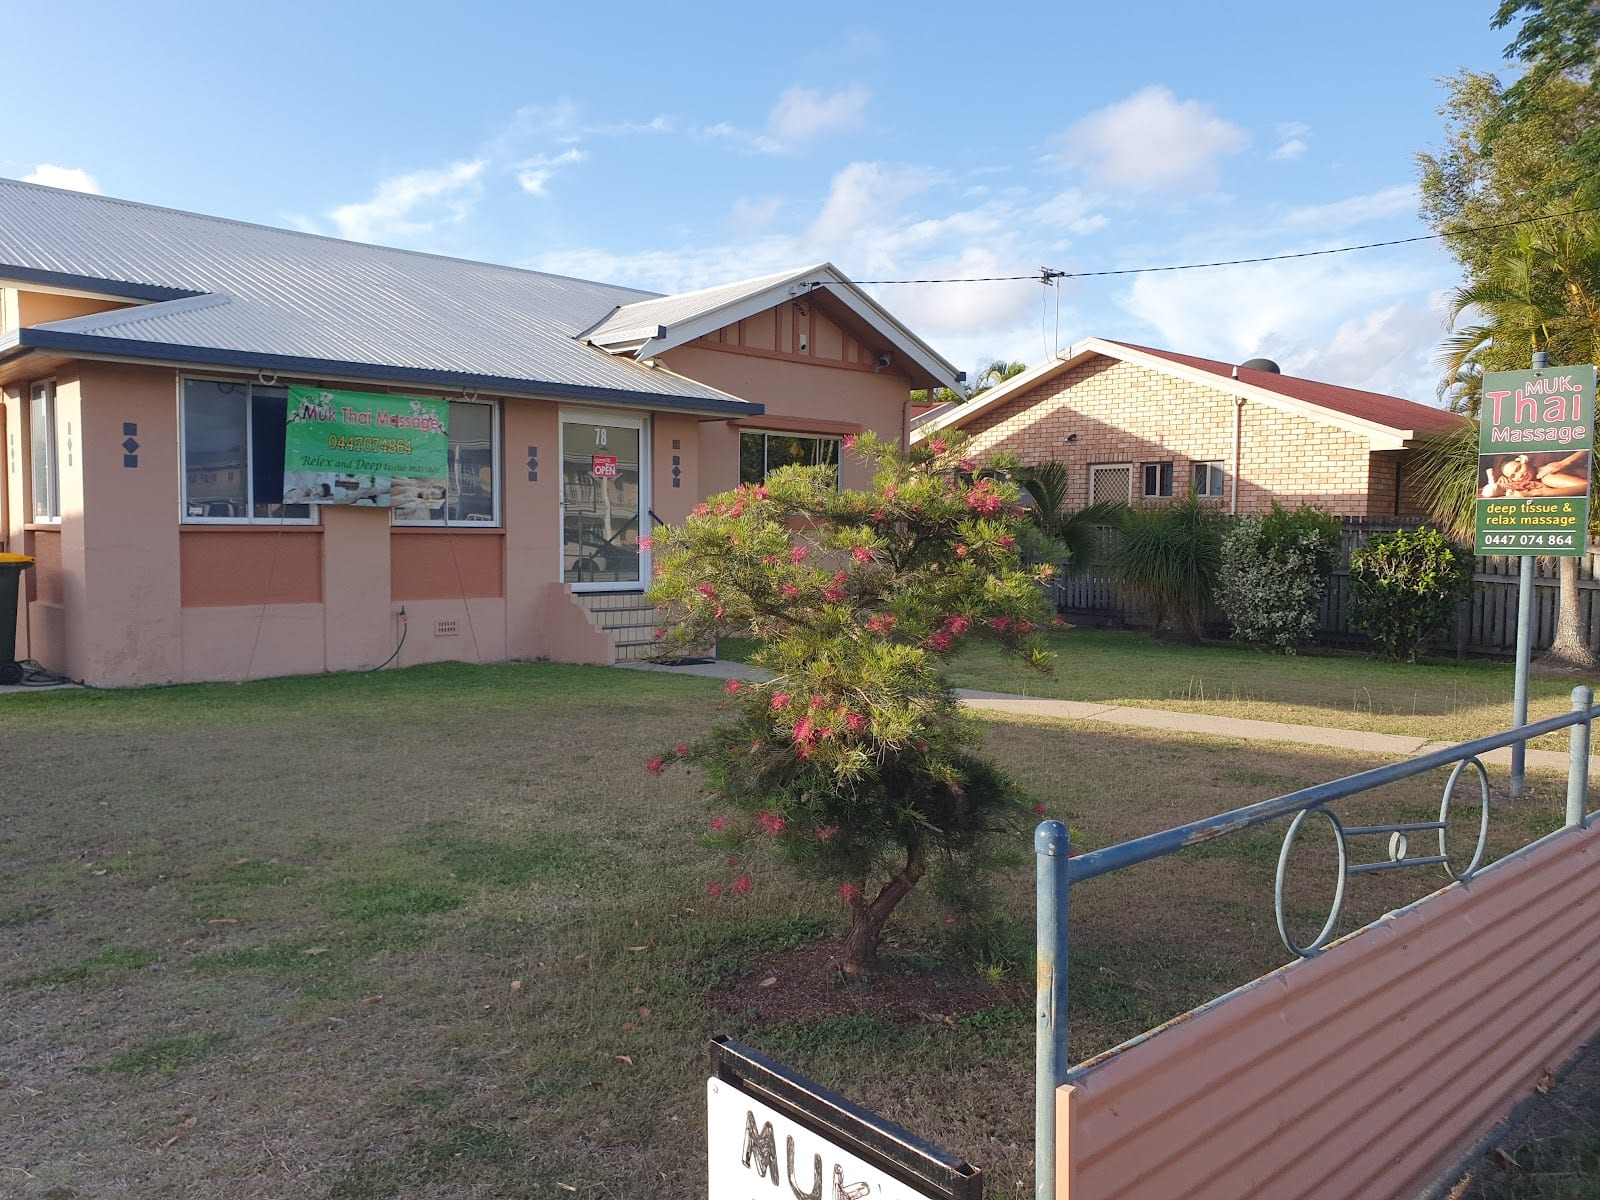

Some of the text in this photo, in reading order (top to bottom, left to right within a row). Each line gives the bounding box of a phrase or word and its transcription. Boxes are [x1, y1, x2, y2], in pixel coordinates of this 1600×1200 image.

[1525, 375, 1573, 396] MUK
[1486, 384, 1583, 426] Thai
[302, 404, 441, 433] Muk Thai Massage
[594, 428, 607, 446] 78
[1491, 425, 1586, 444] Massage
[328, 434, 413, 455] 0447074864
[335, 459, 352, 469] and
[354, 459, 383, 473] Deep
[594, 465, 616, 476] OPEN
[1487, 502, 1572, 515] deep tissue &
[1486, 515, 1576, 527] relax massage
[1485, 535, 1573, 545] 0447 074 864
